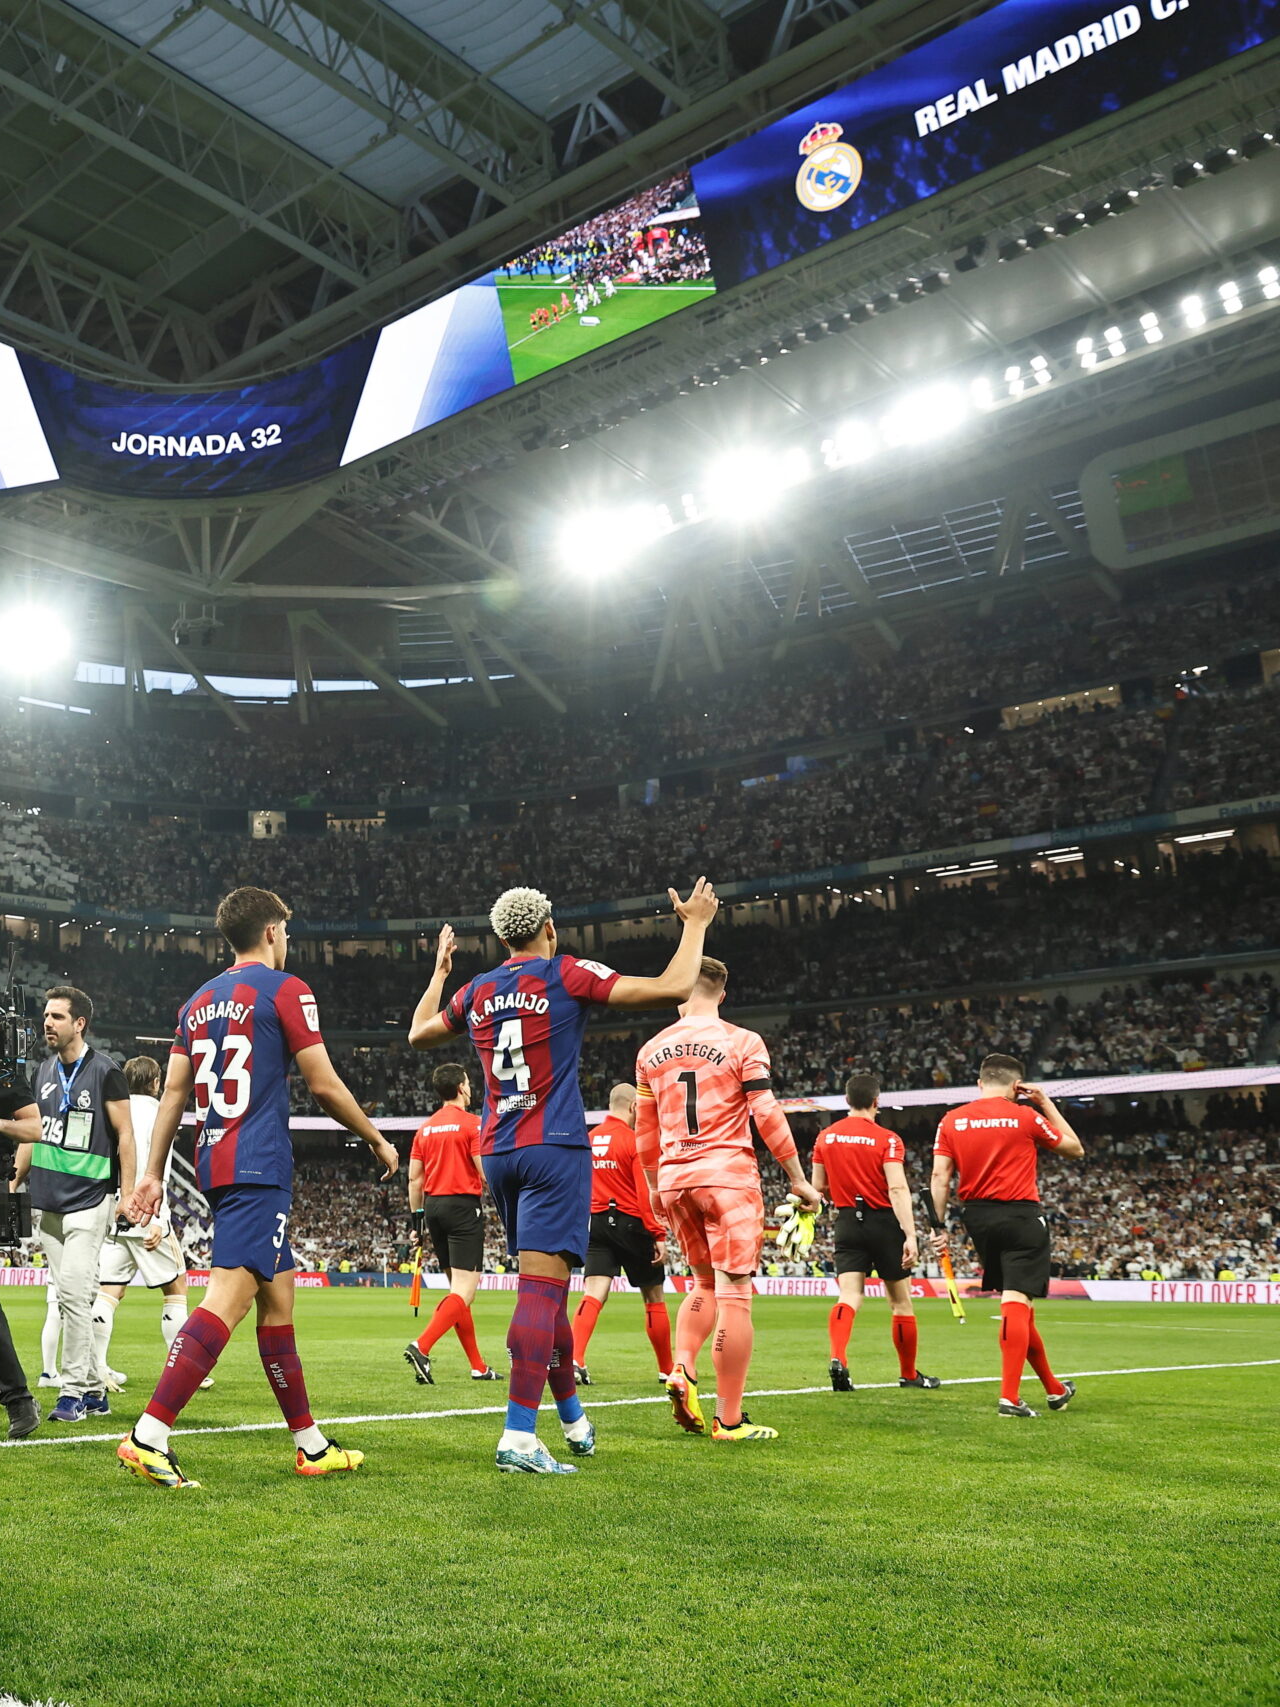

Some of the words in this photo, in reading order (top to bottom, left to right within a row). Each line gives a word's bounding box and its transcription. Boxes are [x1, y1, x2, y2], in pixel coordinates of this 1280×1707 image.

[915, 79, 998, 137] REAL
[1001, 5, 1141, 95] MADRID
[112, 431, 245, 457] JORNADA
[250, 424, 282, 448] 32
[1219, 803, 1254, 818] Real
[1051, 829, 1080, 843] Real
[1083, 821, 1132, 838] Madrid
[901, 856, 929, 868] Real
[325, 920, 358, 932] Madrid
[415, 920, 437, 931] Real
[187, 1000, 255, 1032] CUBARSÍ
[491, 1018, 531, 1092] 4
[191, 1034, 253, 1122] 33
[677, 1070, 700, 1136] 1
[41, 1115, 64, 1145] 219
[592, 1160, 618, 1170] URTH
[9, 1269, 36, 1286] OVER
[766, 1279, 785, 1295] FLY
[787, 1280, 827, 1296] BETTER
[1184, 1283, 1204, 1303] TO
[1211, 1283, 1256, 1304] OVER
[715, 1329, 727, 1352] BARÇA
[167, 1337, 184, 1368] BARÇA
[269, 1362, 289, 1389] BARÇA
